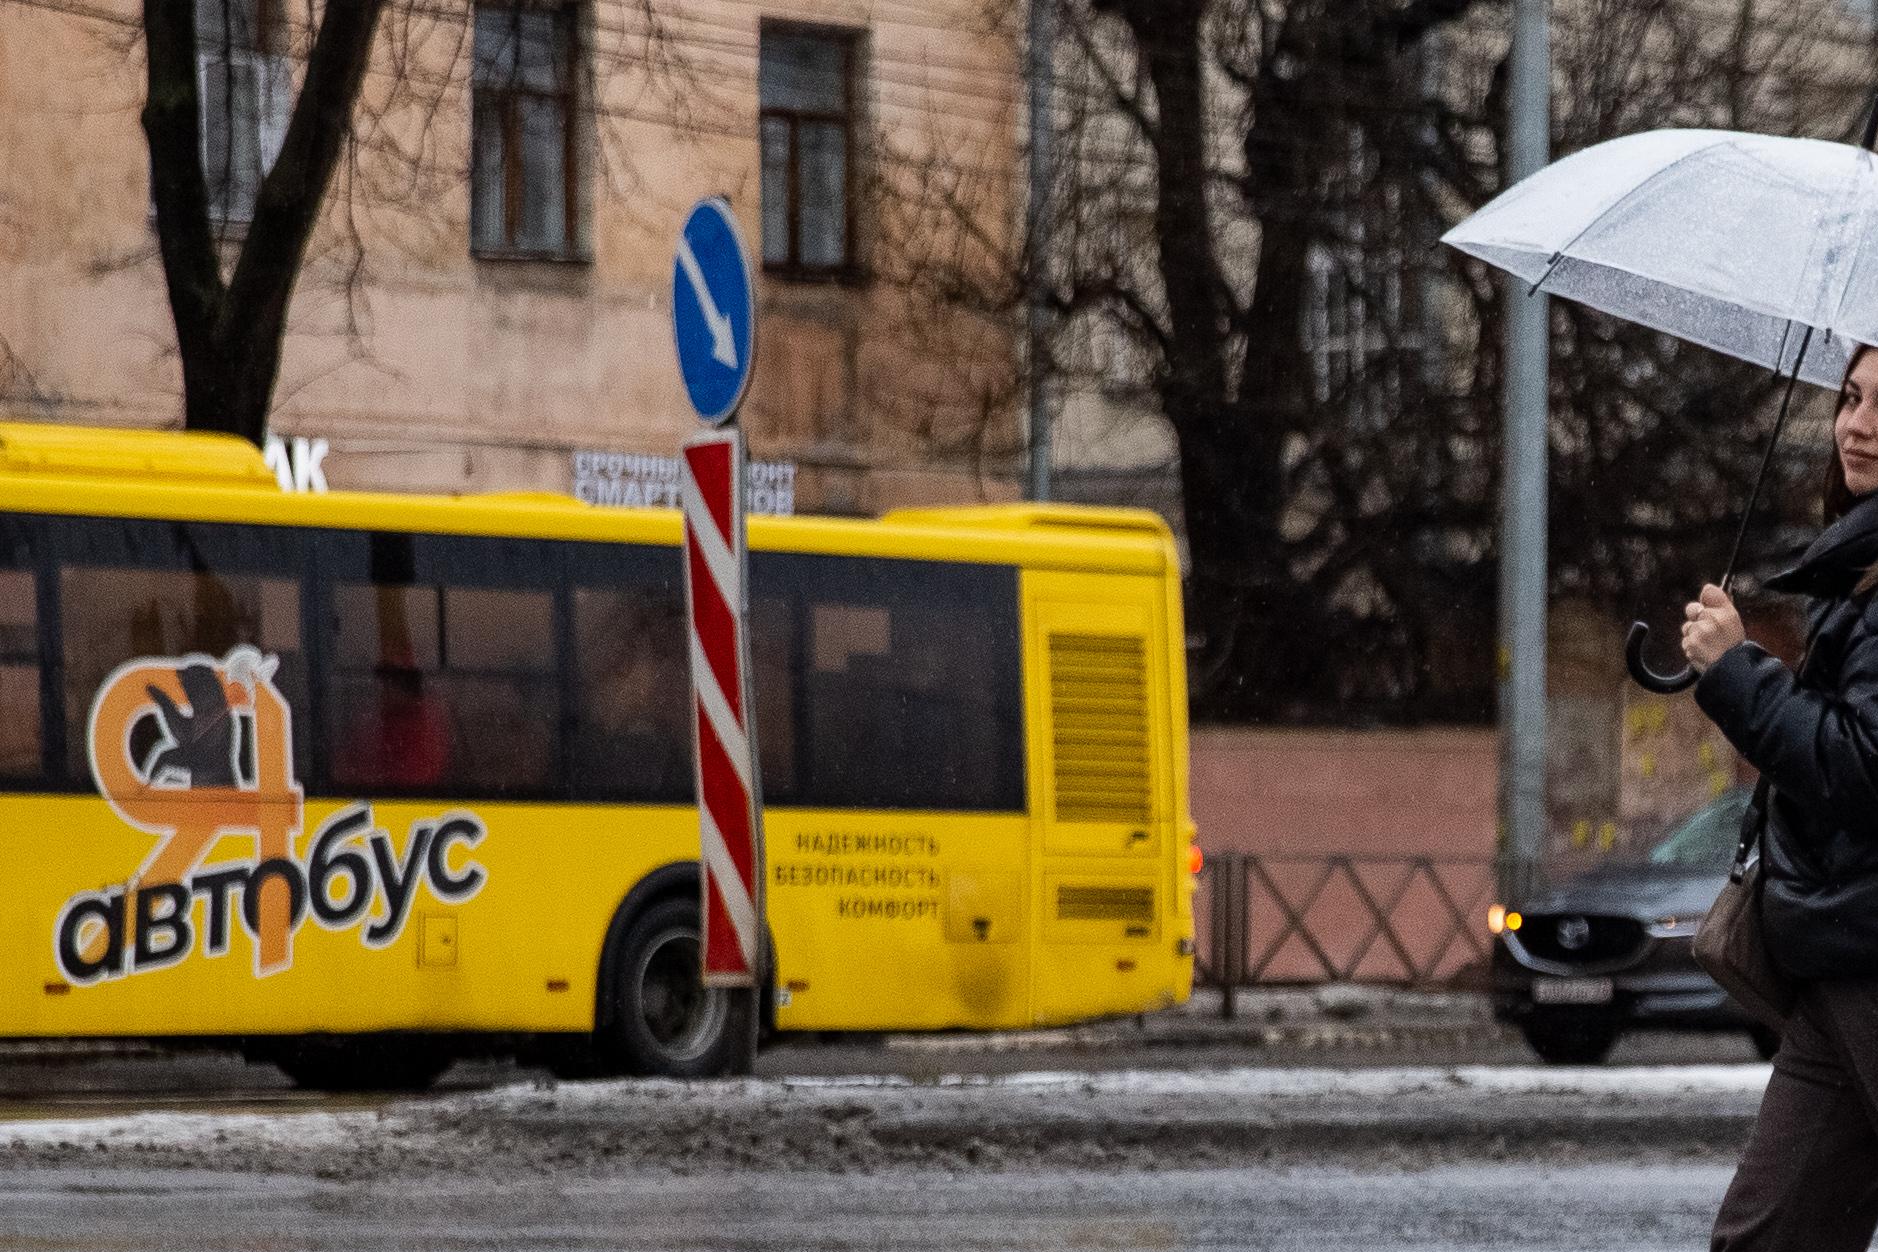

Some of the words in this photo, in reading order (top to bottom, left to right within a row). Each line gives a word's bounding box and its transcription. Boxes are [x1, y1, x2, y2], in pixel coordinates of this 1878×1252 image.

[574, 451, 683, 482] СРОЧНЫ
[795, 831, 940, 857] НАДЕЖНОСТЬ
[774, 863, 941, 889] БЕЗОПАСНОСТЬ
[55, 803, 488, 984] автобус
[837, 896, 940, 921] КОМФОРТ
